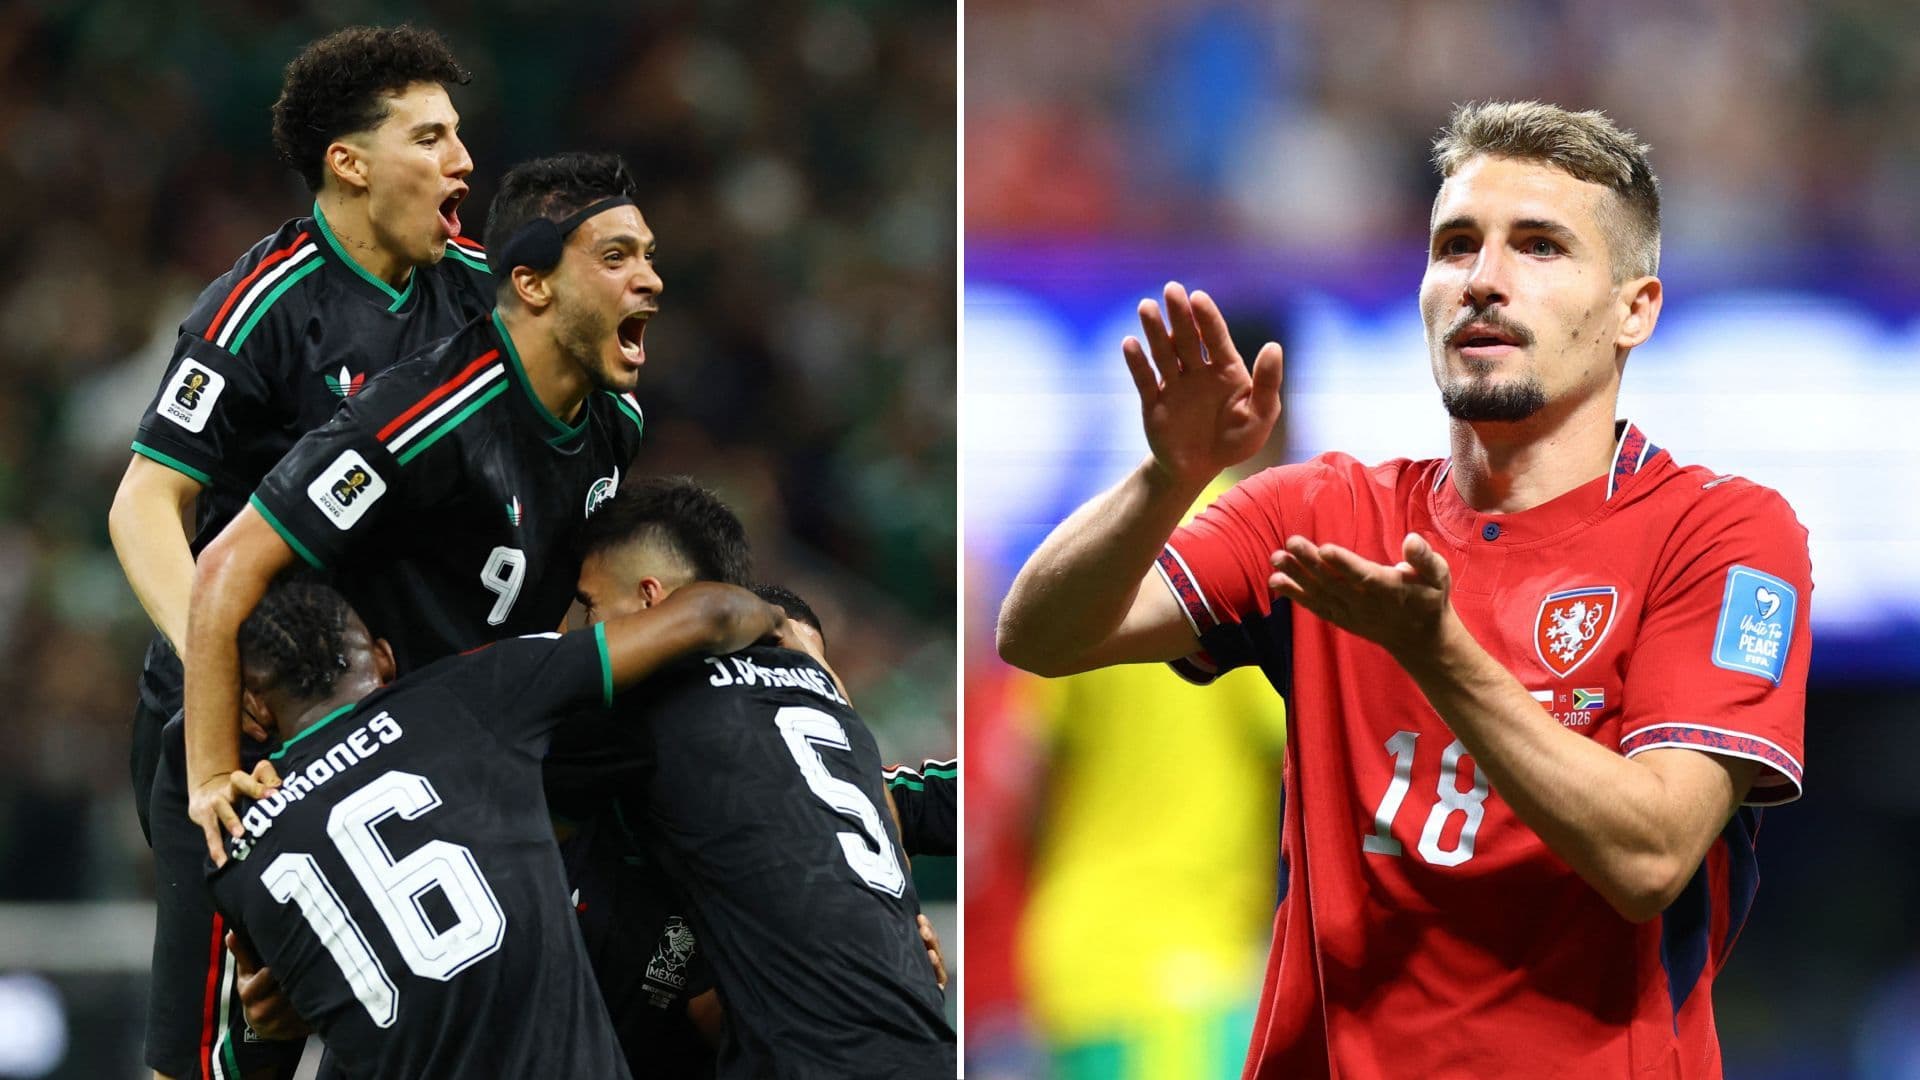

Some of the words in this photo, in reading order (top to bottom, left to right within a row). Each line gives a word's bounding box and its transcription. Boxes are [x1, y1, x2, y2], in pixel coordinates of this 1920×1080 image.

[167, 406, 191, 423] 2026
[319, 495, 341, 518] 2026
[480, 545, 527, 626] 9
[1739, 633, 1780, 659] PEACE
[1563, 711, 1591, 726] 2026
[774, 706, 906, 899] 5
[1363, 730, 1489, 867] 18
[260, 770, 507, 1028] 16
